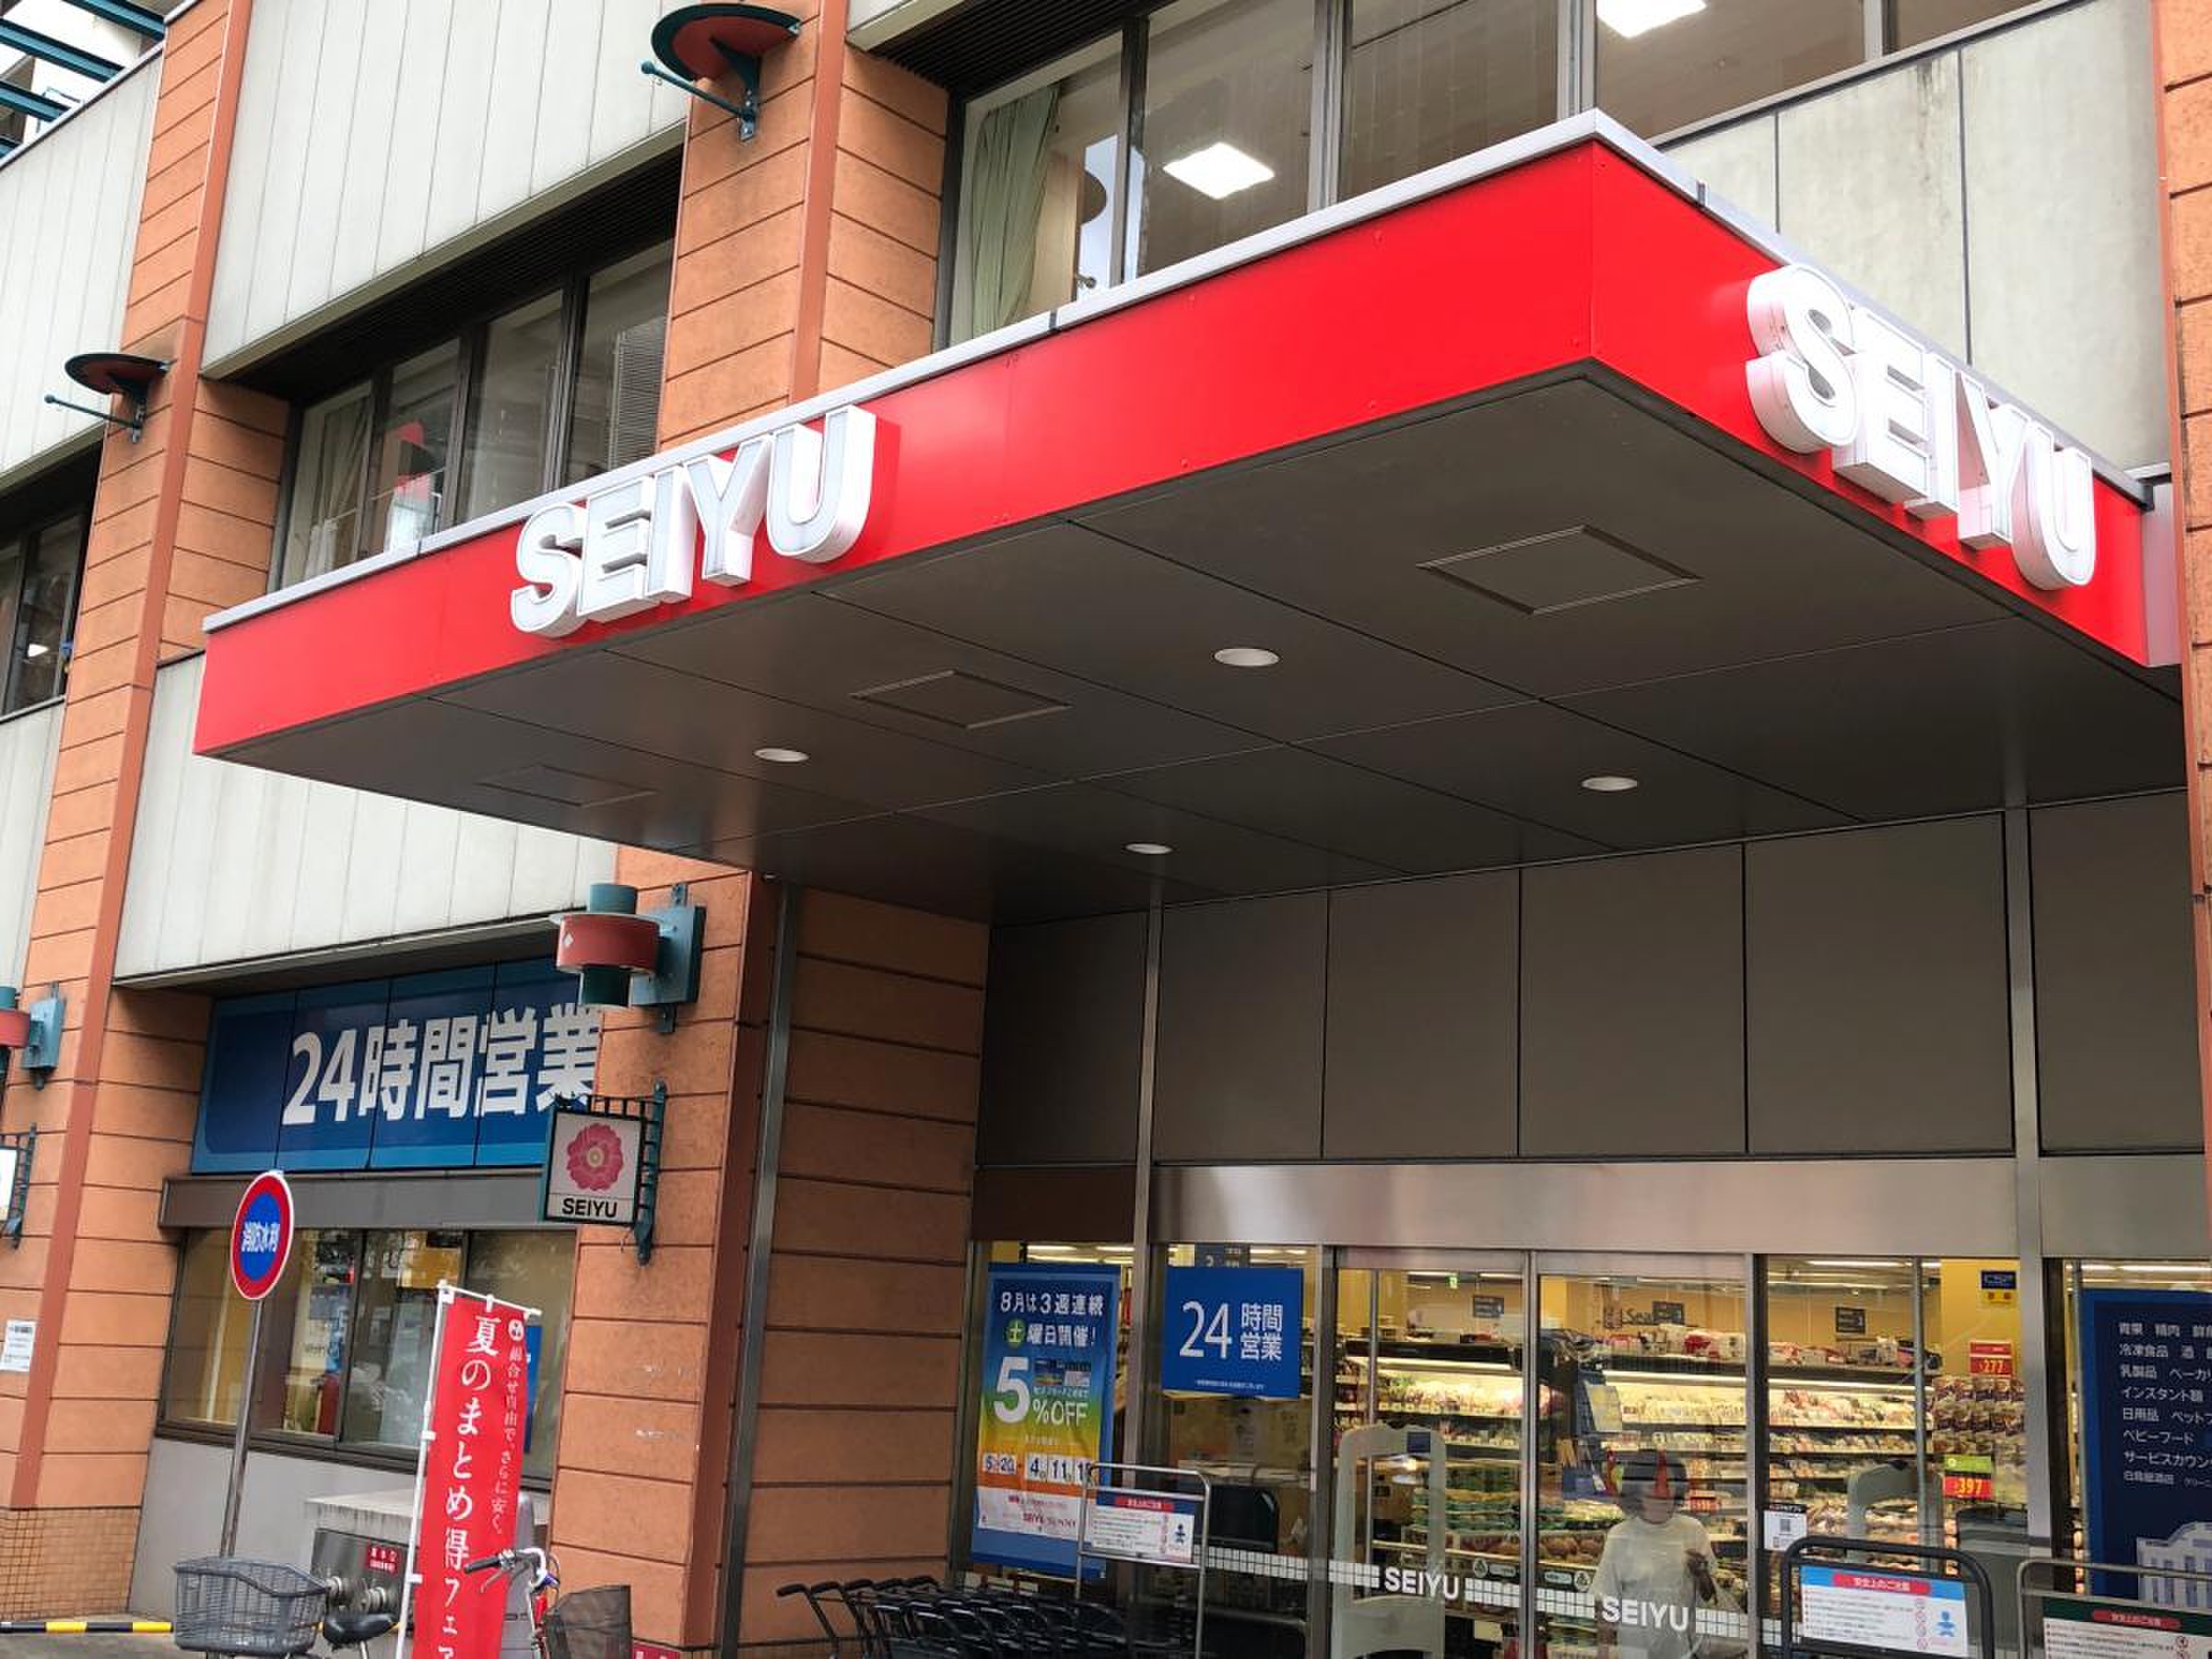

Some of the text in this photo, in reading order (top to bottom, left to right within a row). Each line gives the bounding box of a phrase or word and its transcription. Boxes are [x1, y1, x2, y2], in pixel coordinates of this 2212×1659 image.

[1747, 264, 2097, 591] SEIYU
[511, 404, 877, 638] SEIYU
[282, 1002, 600, 1125] 24時間営業
[561, 1197, 618, 1218] SEIYU
[1000, 1291, 1104, 1316] 8月は3週連続
[1179, 1300, 1284, 1359] 24 時間
[1240, 1332, 1282, 1361] 営業
[2119, 1344, 2169, 1358] 冷凍食品
[994, 1356, 1088, 1426] 5 %OFF
[2123, 1407, 2159, 1422] 日用品
[2124, 1450, 2212, 1469] サービスカウン
[1384, 1570, 1460, 1601] SEIYU
[1602, 1595, 1689, 1631] SEIYU
